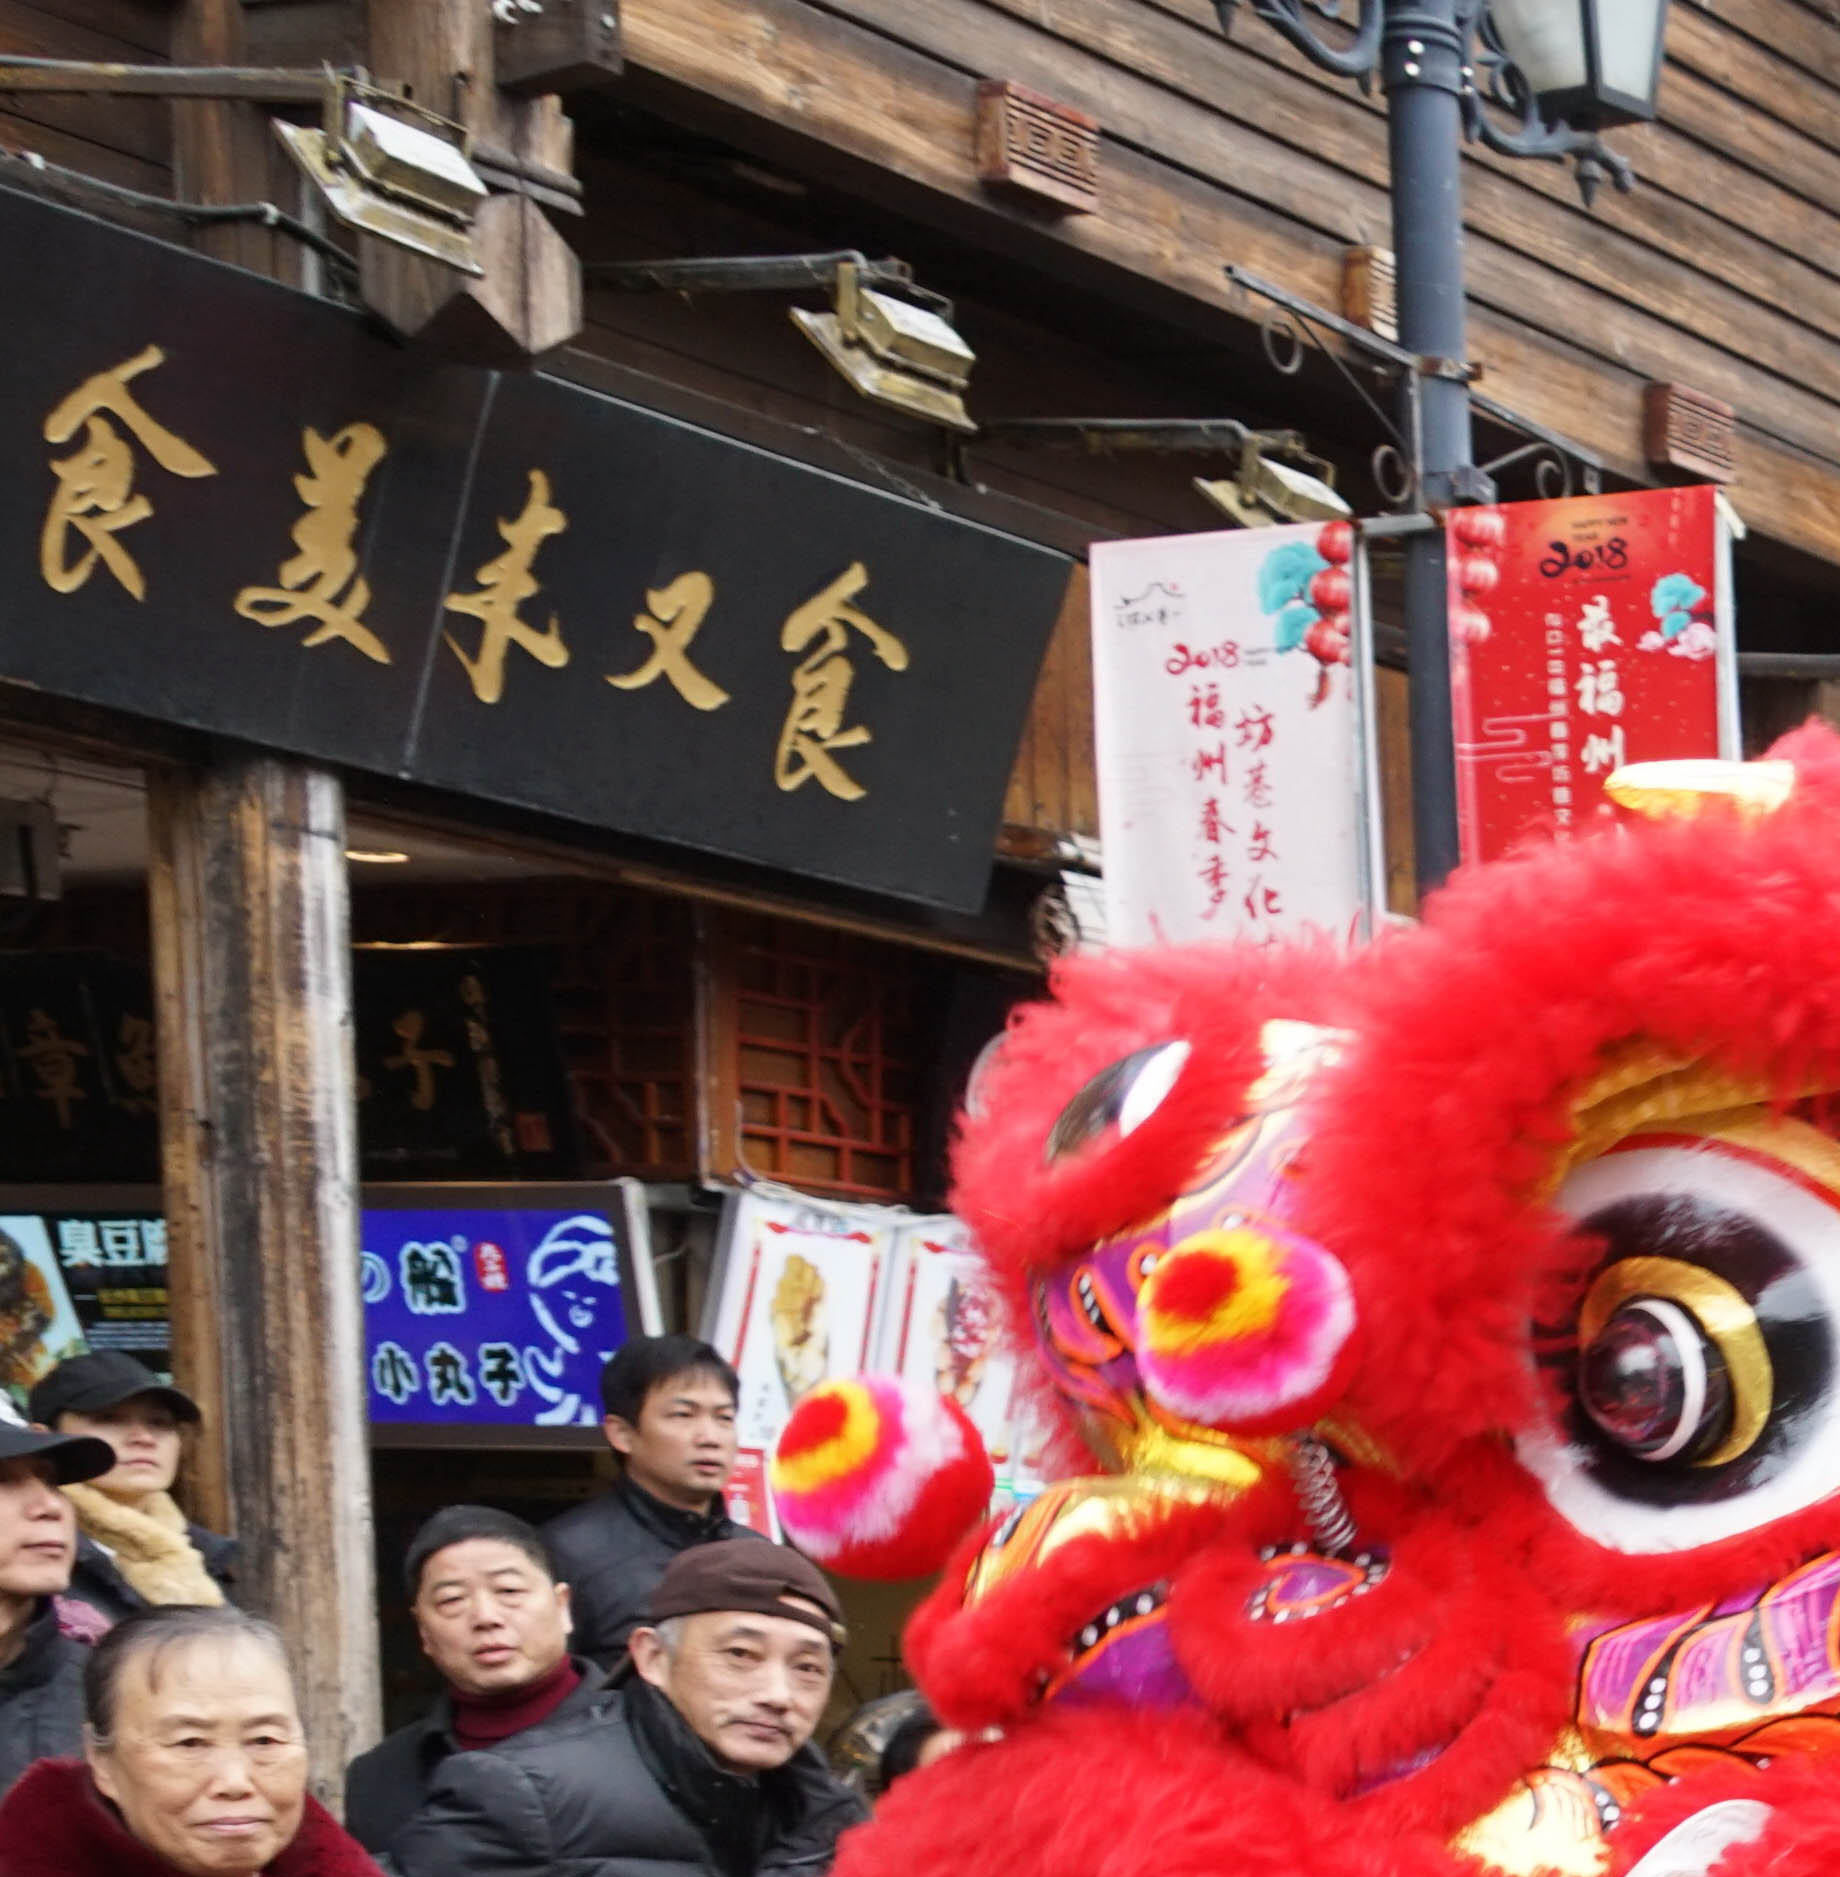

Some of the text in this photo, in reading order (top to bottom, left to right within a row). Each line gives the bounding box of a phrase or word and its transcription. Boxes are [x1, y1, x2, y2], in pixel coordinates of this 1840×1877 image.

[1539, 537, 1628, 578] 2018
[1166, 640, 1239, 674] 2018
[1573, 594, 1628, 842] 最福州
